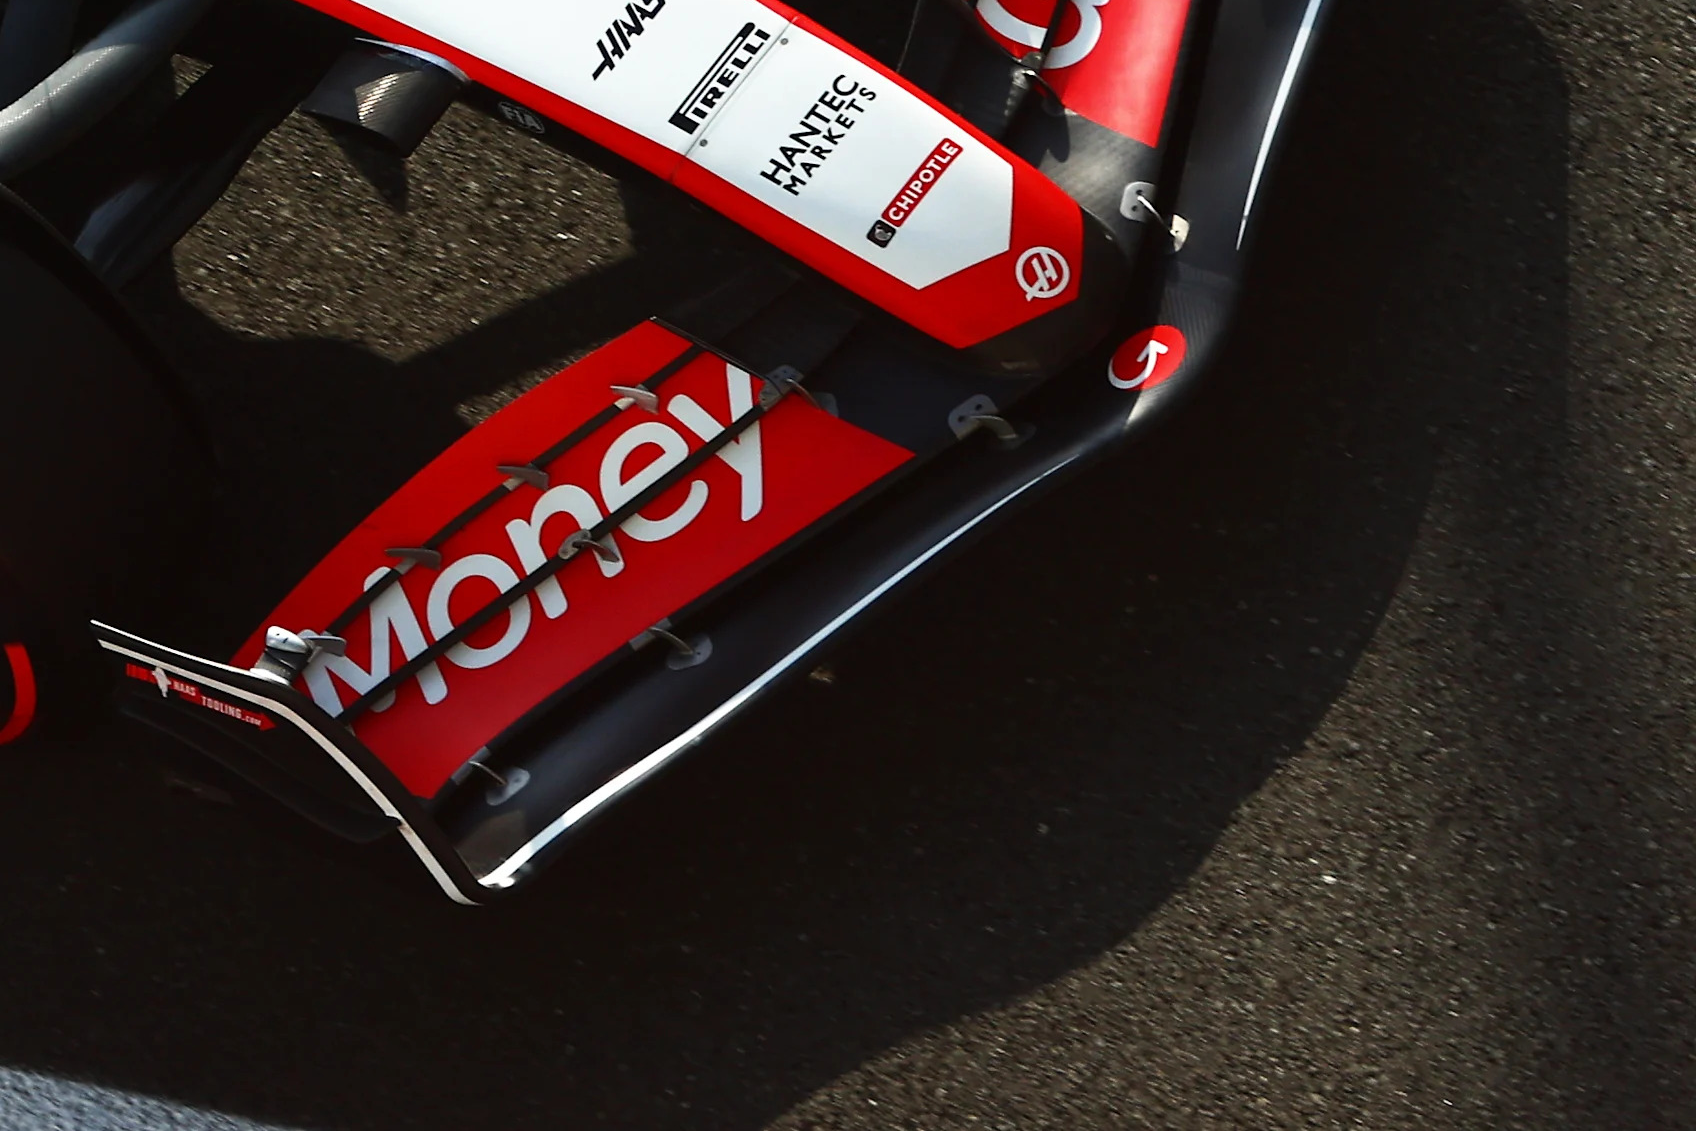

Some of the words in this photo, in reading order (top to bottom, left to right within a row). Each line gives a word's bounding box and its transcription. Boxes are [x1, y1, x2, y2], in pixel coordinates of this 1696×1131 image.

[668, 22, 771, 135] PIRELLI
[760, 74, 860, 186] HANTEC
[782, 87, 877, 196] MARKETS
[888, 140, 960, 221] CHIPOTLE
[297, 363, 764, 716] Money
[173, 680, 197, 697] HAAS
